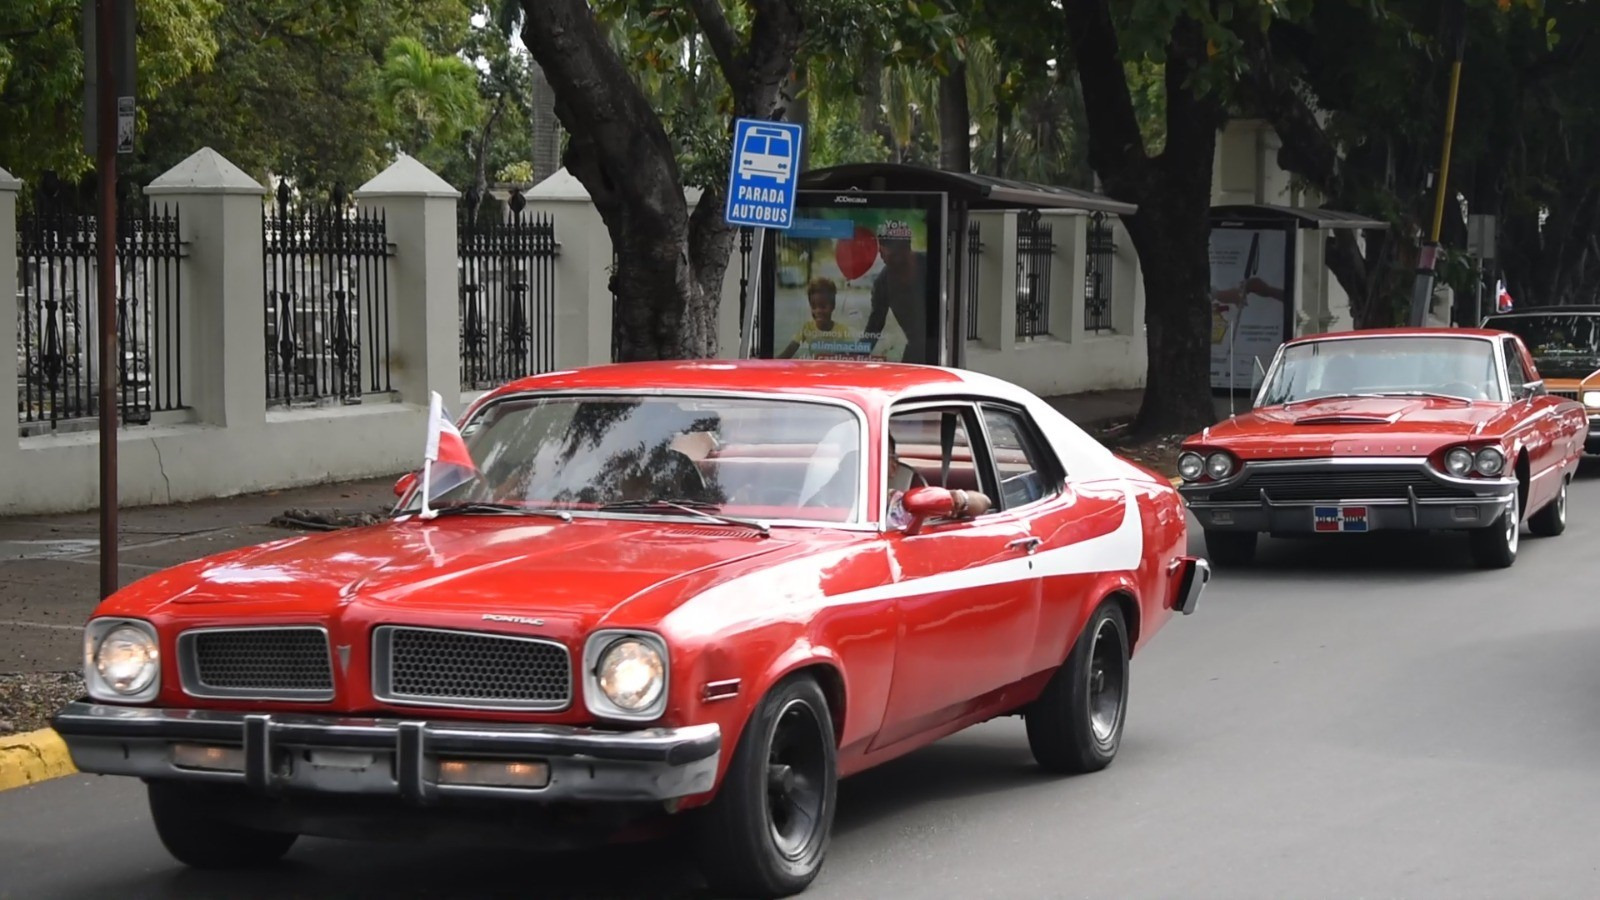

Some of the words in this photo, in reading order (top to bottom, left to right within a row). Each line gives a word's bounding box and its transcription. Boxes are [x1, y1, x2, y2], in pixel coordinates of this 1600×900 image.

[738, 185, 785, 204] PARADA
[732, 203, 788, 223] AUTOBUS
[811, 340, 871, 351] eliminación
[481, 613, 545, 626] PONTIAC
